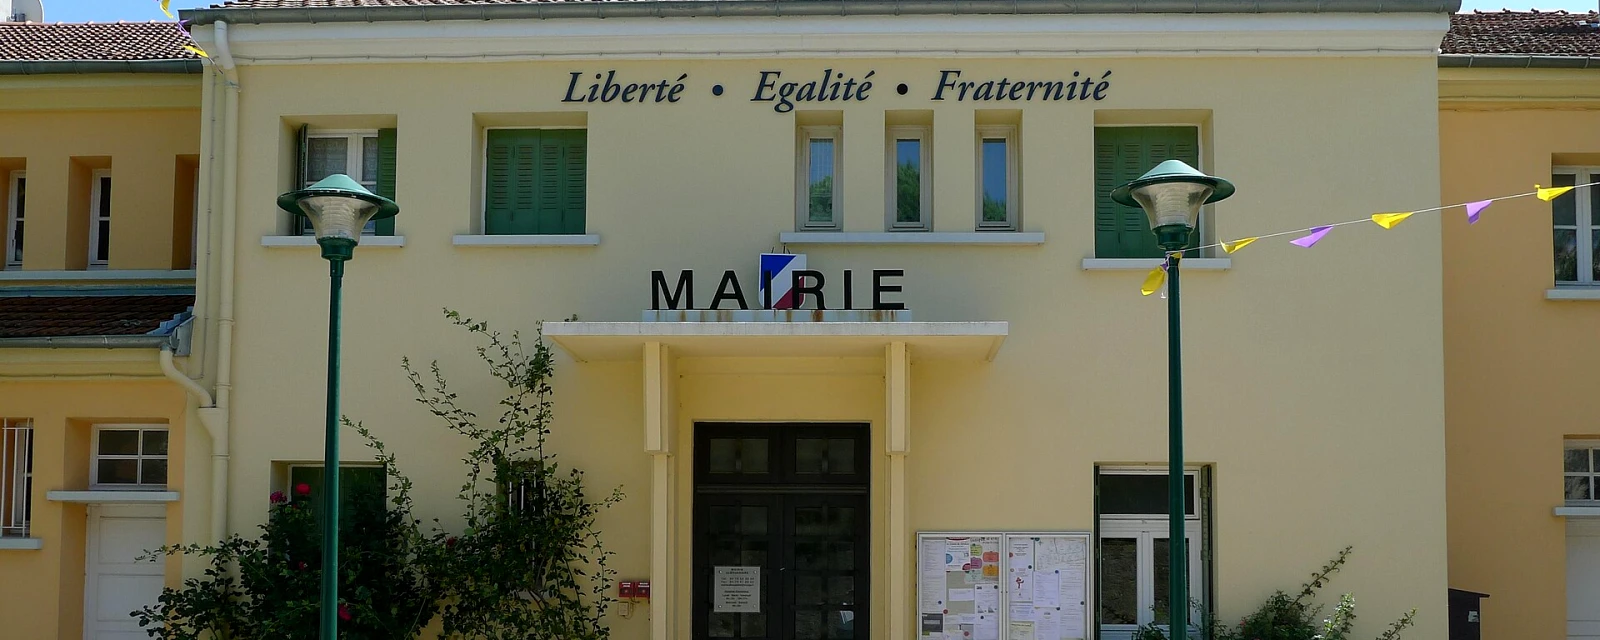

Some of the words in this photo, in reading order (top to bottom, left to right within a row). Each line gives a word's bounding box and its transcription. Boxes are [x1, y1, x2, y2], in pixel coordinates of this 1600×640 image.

[561, 70, 688, 104] Liberté
[751, 69, 875, 113] Egalité
[931, 69, 1112, 104] Fraternité
[651, 270, 905, 310] MAIRIE
